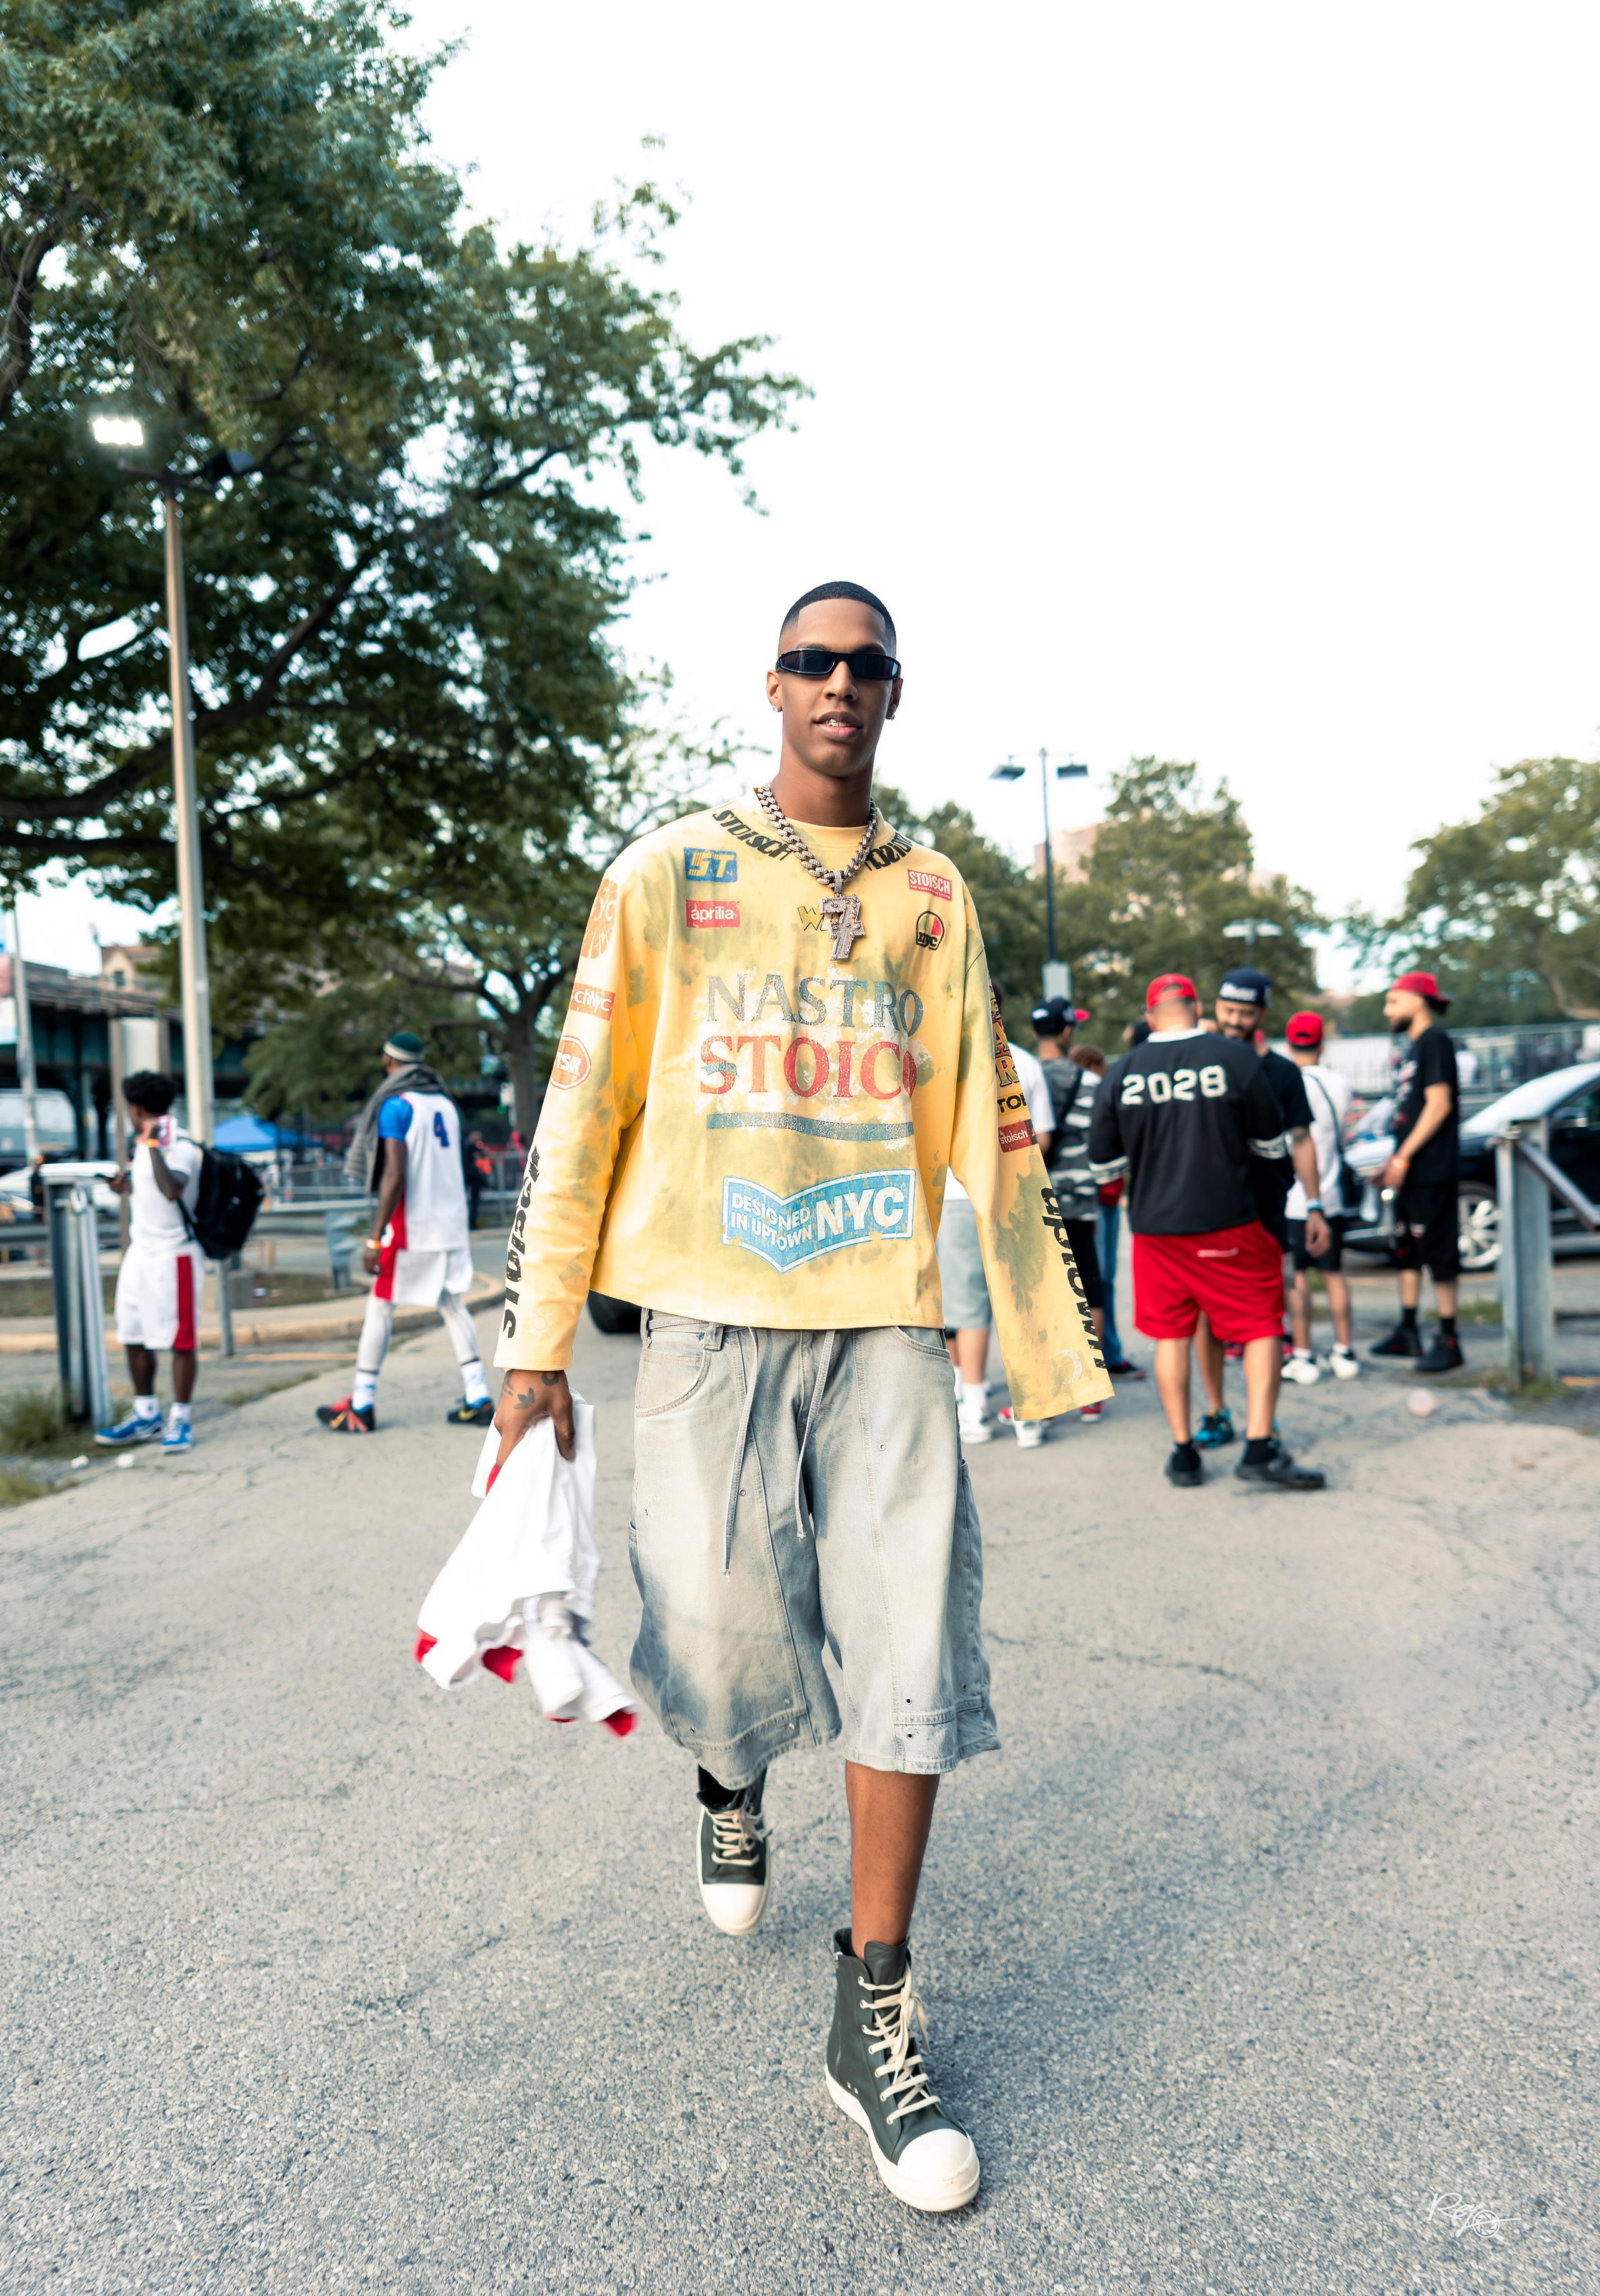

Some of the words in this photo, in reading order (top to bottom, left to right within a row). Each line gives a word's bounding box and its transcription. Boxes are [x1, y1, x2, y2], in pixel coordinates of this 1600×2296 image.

[688, 852, 734, 878] ST
[909, 871, 951, 894] STOISCH
[691, 906, 734, 923] aprilia
[706, 974, 923, 1037] NASTRO
[1121, 1064, 1228, 1106] 2028
[434, 1112, 450, 1147] 4
[1000, 1129, 1029, 1144] stoisch
[732, 1192, 811, 1231] DESIGNED
[816, 1186, 904, 1241] NYC
[731, 1211, 749, 1231] IN
[751, 1219, 812, 1250] UPTOWN
